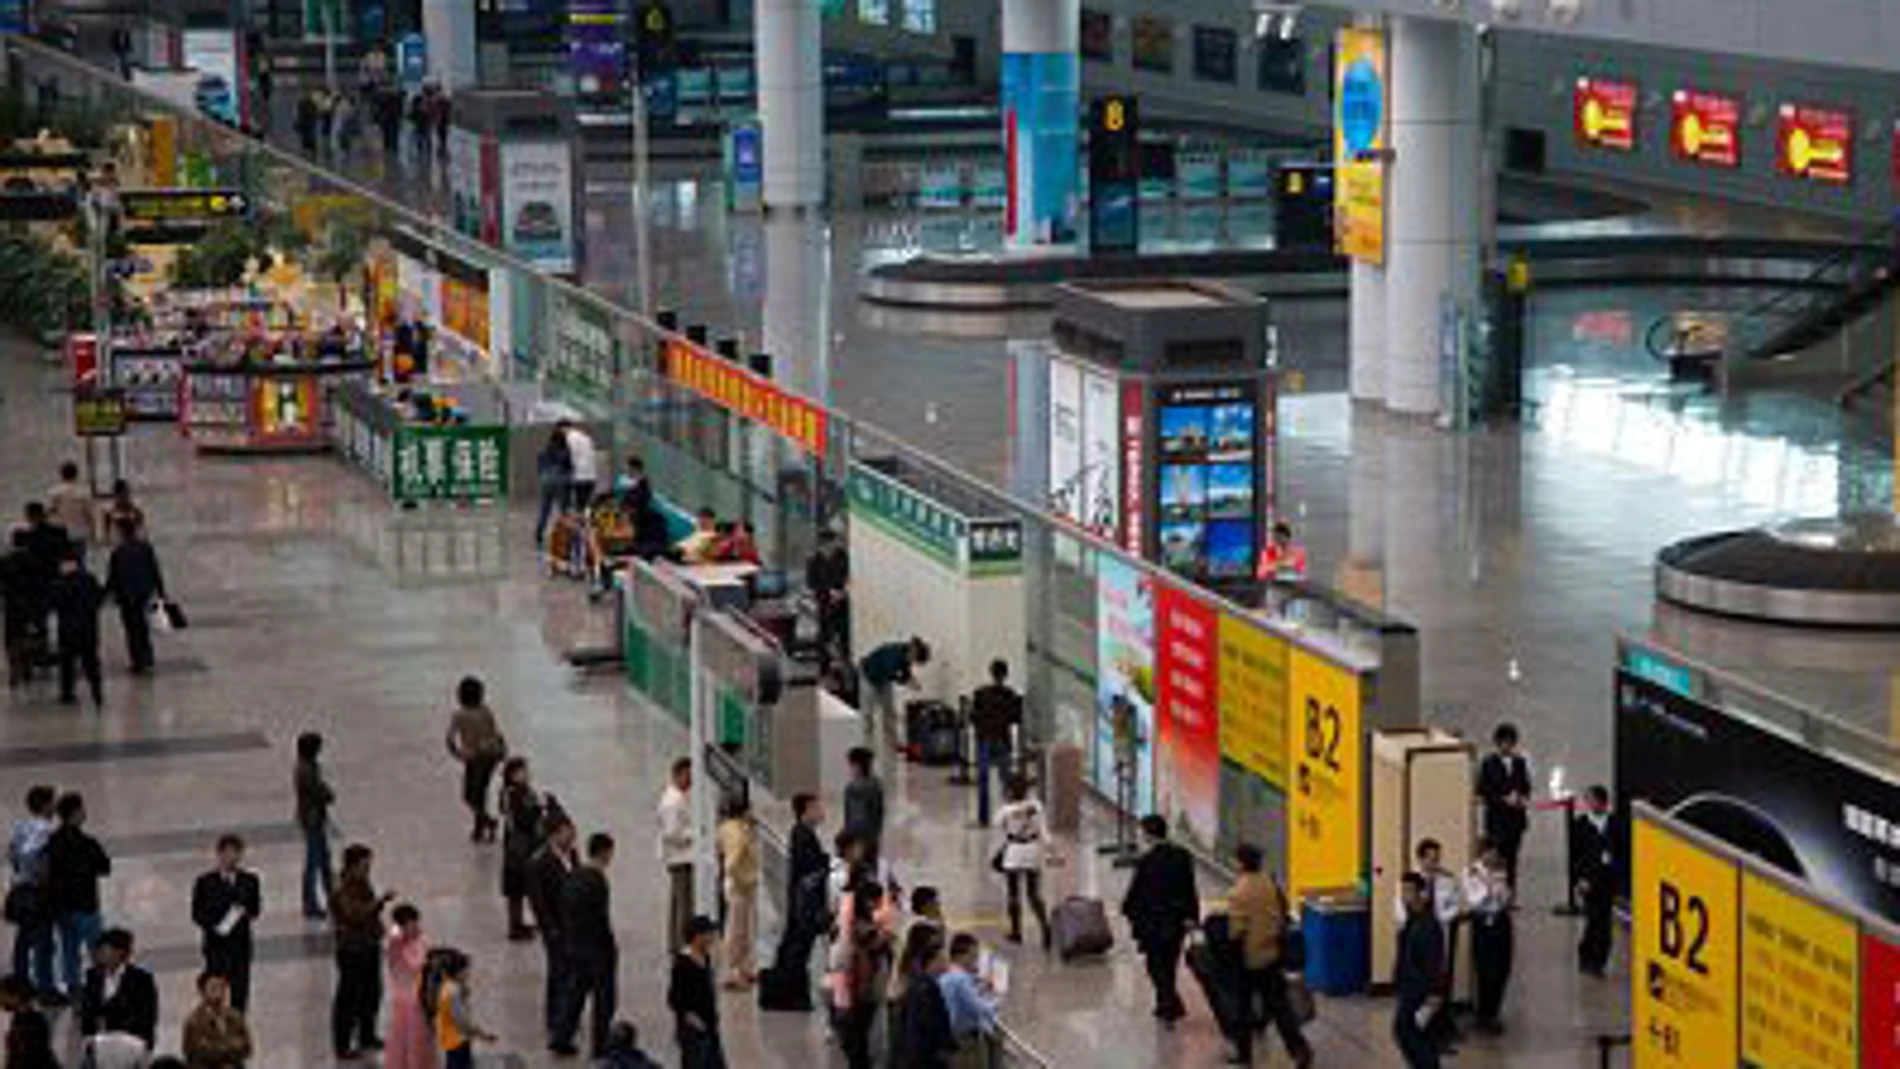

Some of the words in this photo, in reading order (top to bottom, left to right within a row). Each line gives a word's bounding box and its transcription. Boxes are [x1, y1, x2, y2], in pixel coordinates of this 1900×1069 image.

[1107, 100, 1124, 131] 8
[1305, 695, 1341, 773] B2
[1660, 880, 1710, 975] B2
